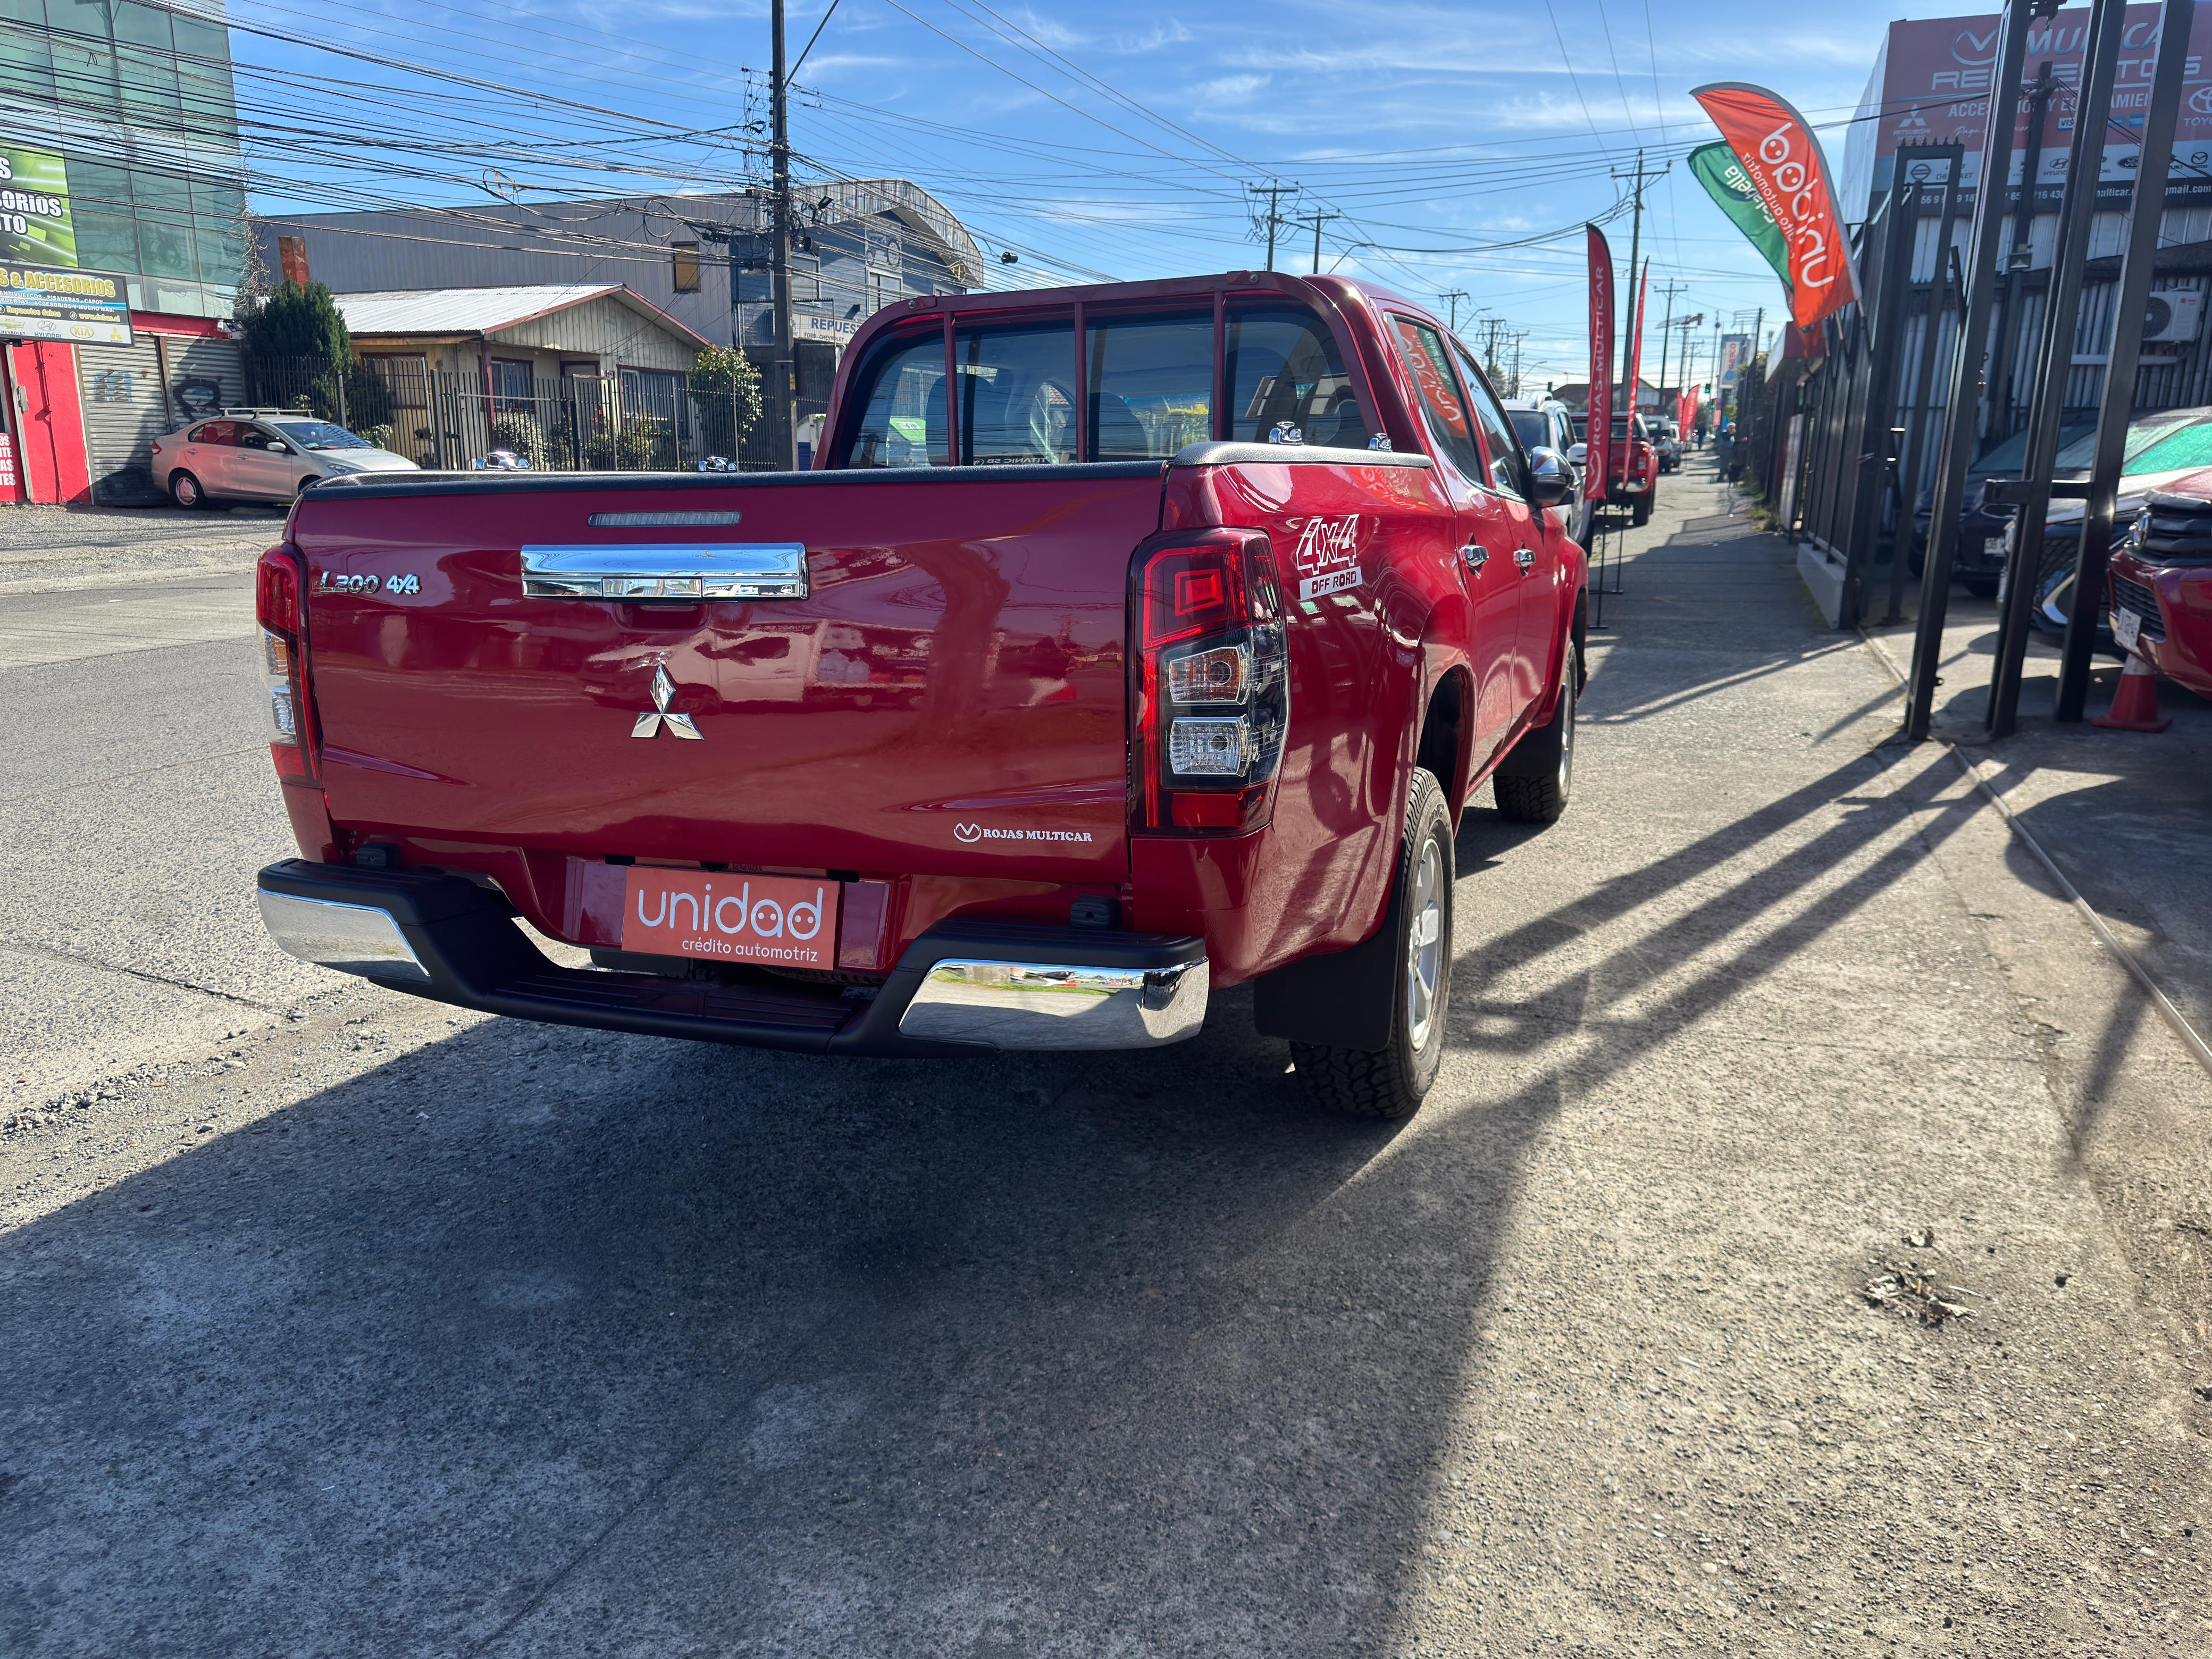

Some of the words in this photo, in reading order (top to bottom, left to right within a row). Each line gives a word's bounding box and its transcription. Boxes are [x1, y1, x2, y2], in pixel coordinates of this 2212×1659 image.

[0, 190, 62, 217] ORIOS
[10, 272, 23, 288] &
[24, 271, 115, 297] ACCESORIOS
[7, 306, 40, 315] Repuestos
[42, 308, 61, 317] dabas
[79, 313, 120, 322] www.dabas.cl
[74, 327, 90, 336] KIA
[811, 317, 861, 335] REPUES
[1593, 380, 1603, 446] ROJAS
[319, 571, 379, 594] L200
[1311, 577, 1330, 594] OFF
[1333, 571, 1356, 588] ROAD
[983, 828, 1024, 839] ROJAS
[1026, 830, 1093, 842] MULTICAR
[638, 882, 823, 940] unidad
[682, 936, 731, 954] crédito
[735, 943, 818, 962] automotriz
